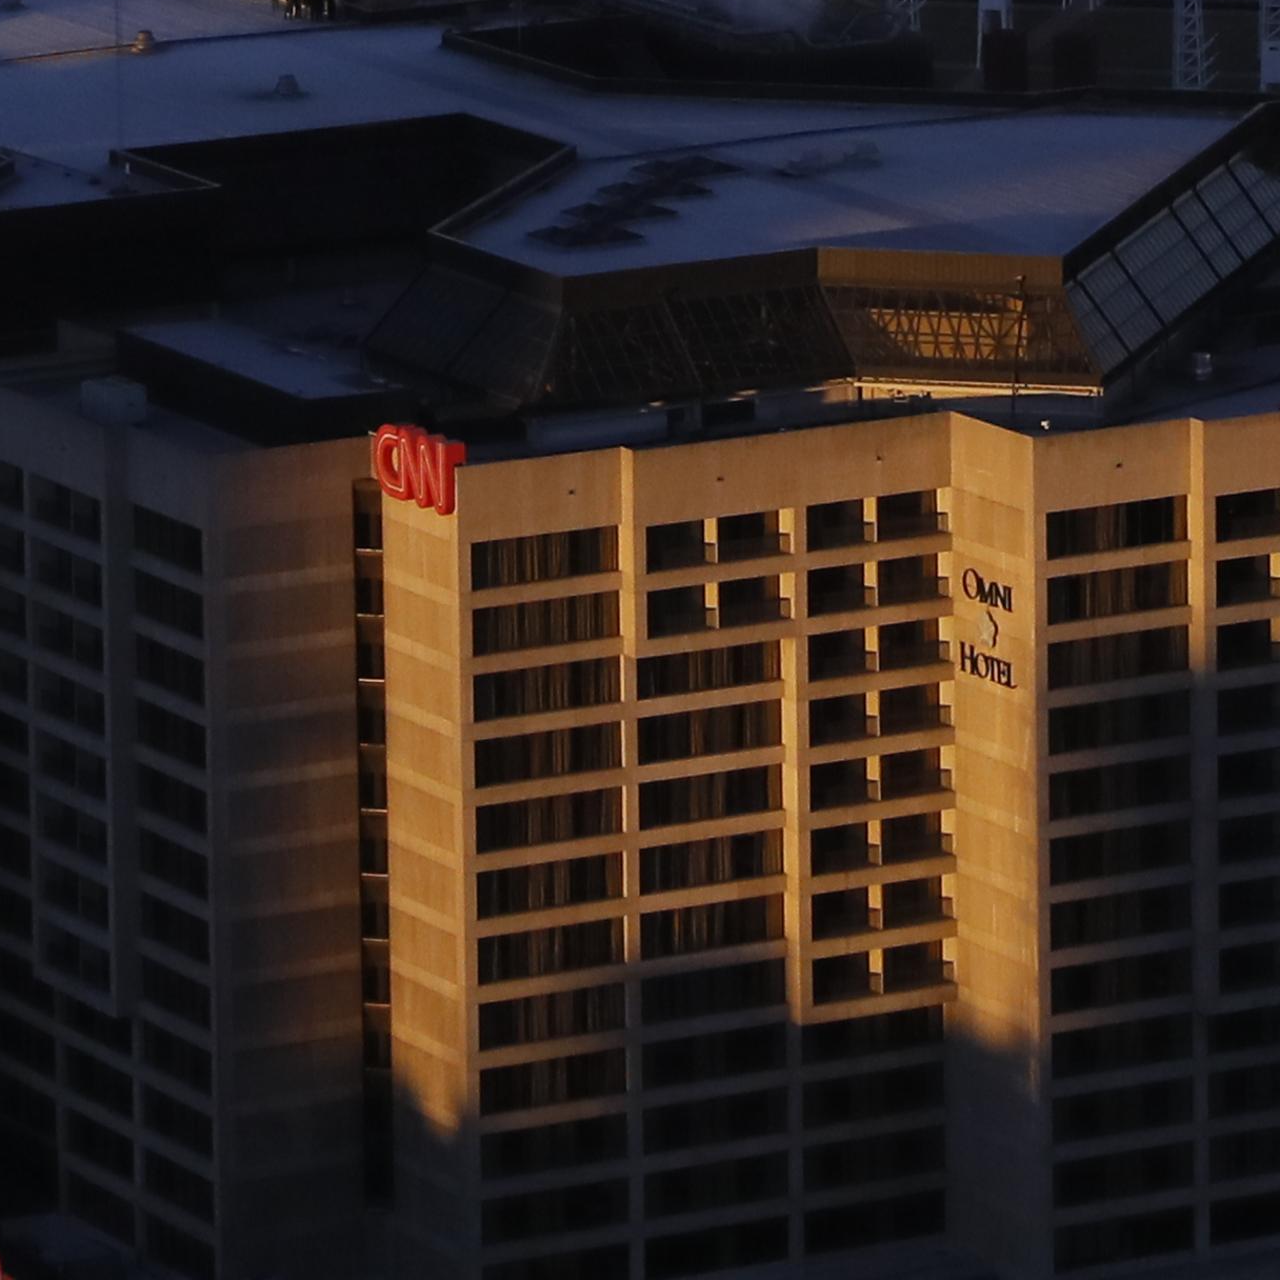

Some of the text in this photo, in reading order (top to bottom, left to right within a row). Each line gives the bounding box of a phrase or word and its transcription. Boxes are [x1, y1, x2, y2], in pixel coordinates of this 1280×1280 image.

[371, 423, 460, 516] CNN
[962, 567, 1013, 613] OMNI
[960, 641, 1017, 689] HOTEL
